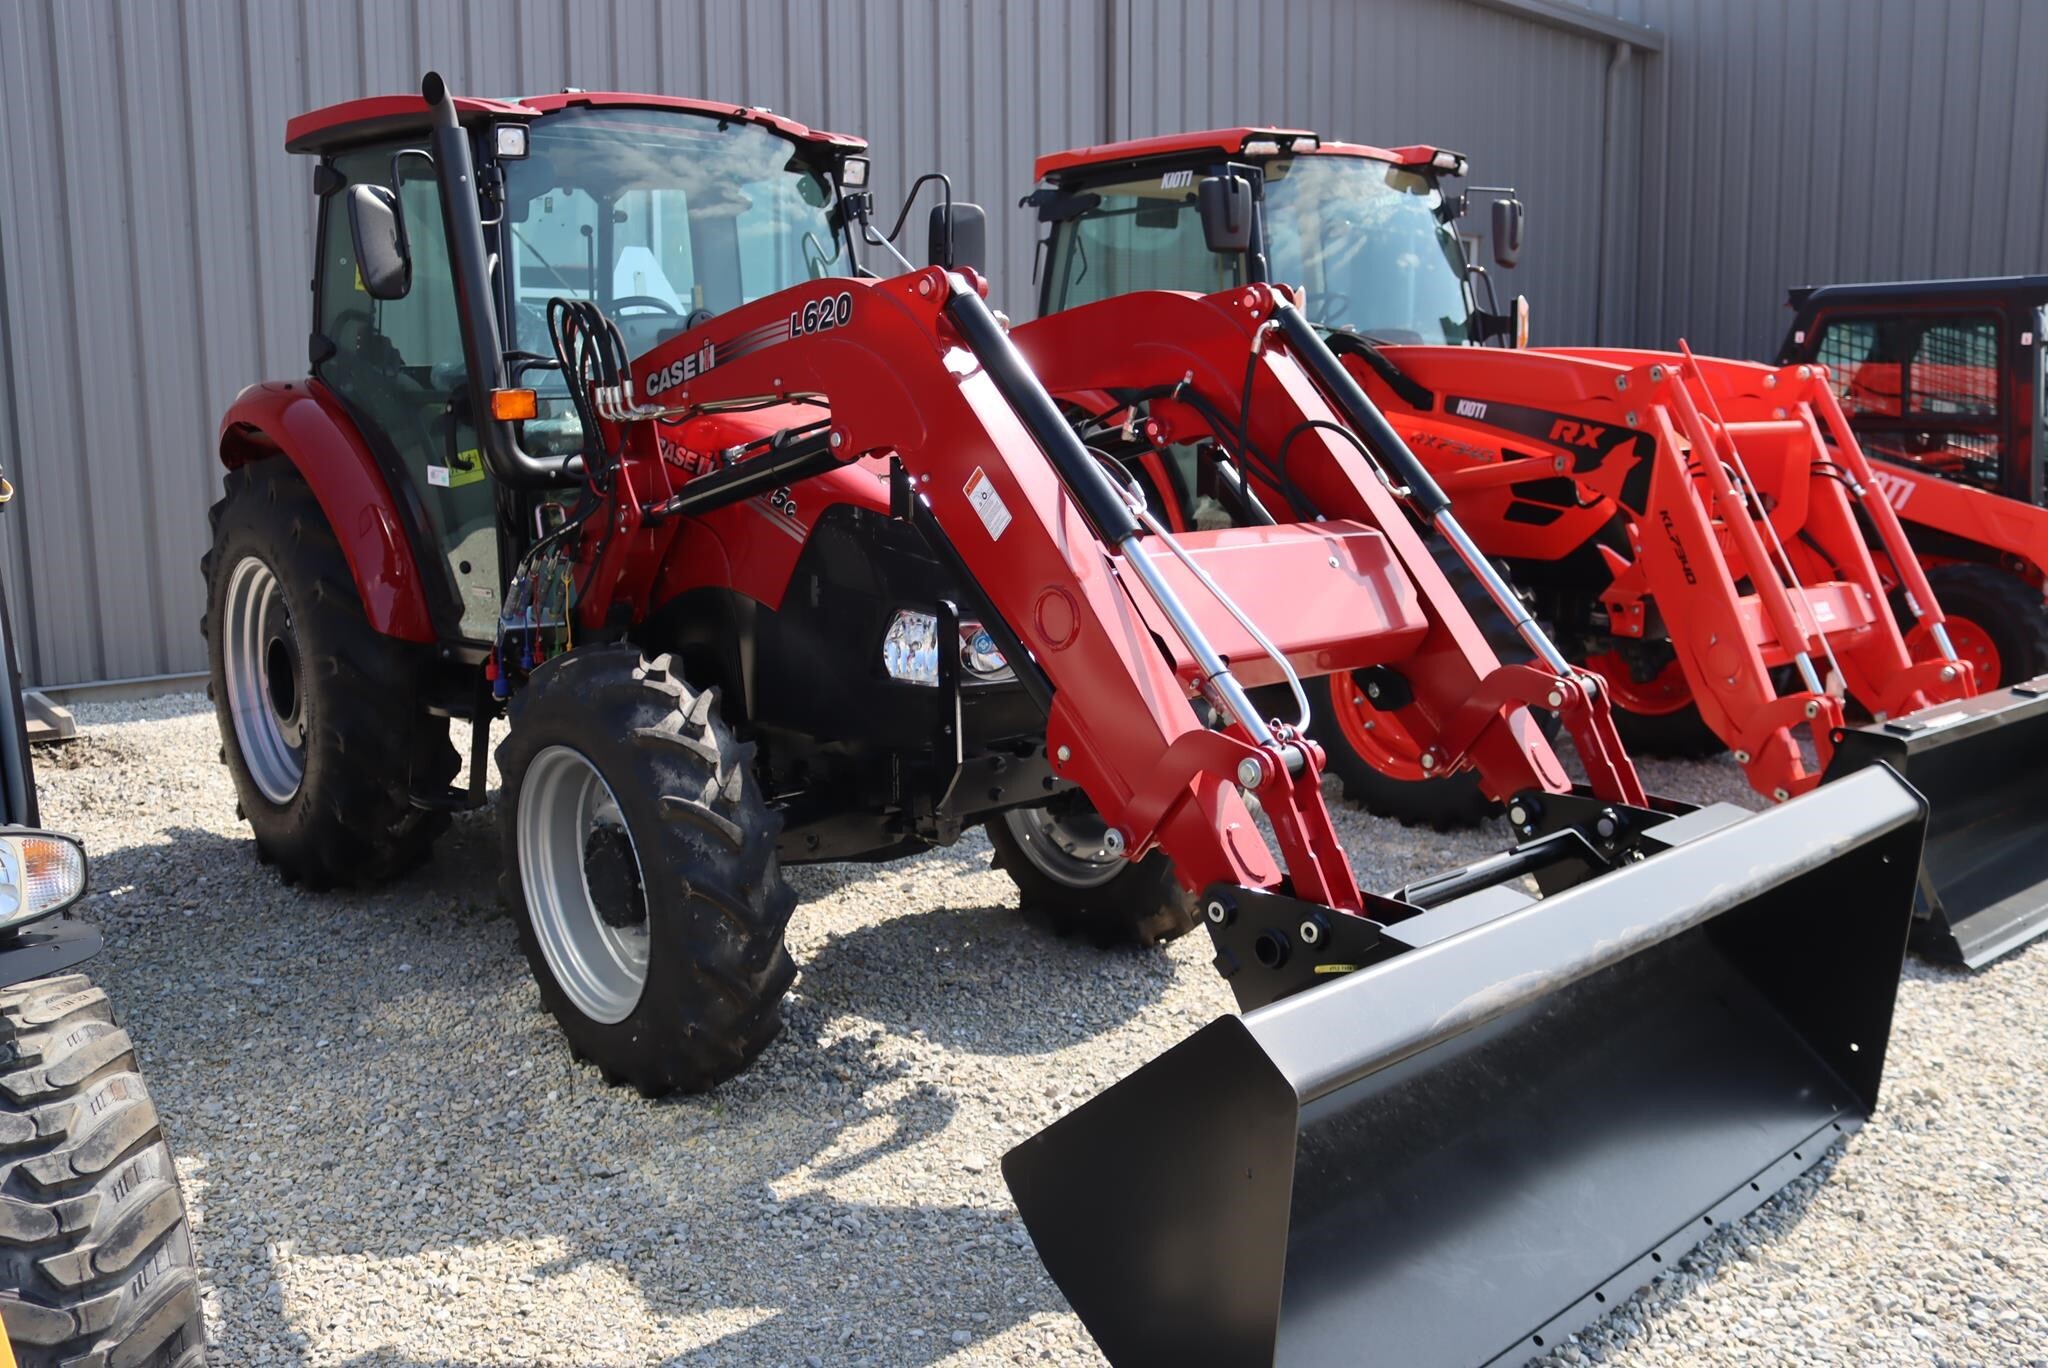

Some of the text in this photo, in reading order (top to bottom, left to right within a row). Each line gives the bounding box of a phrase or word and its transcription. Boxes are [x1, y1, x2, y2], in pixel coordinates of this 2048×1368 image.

[1161, 170, 1194, 190] KIOTI
[789, 291, 852, 339] L620
[645, 353, 697, 397] CASE
[1456, 399, 1488, 420] KIOTI
[1550, 418, 1606, 449] RX
[1659, 510, 1698, 585] KL7340
